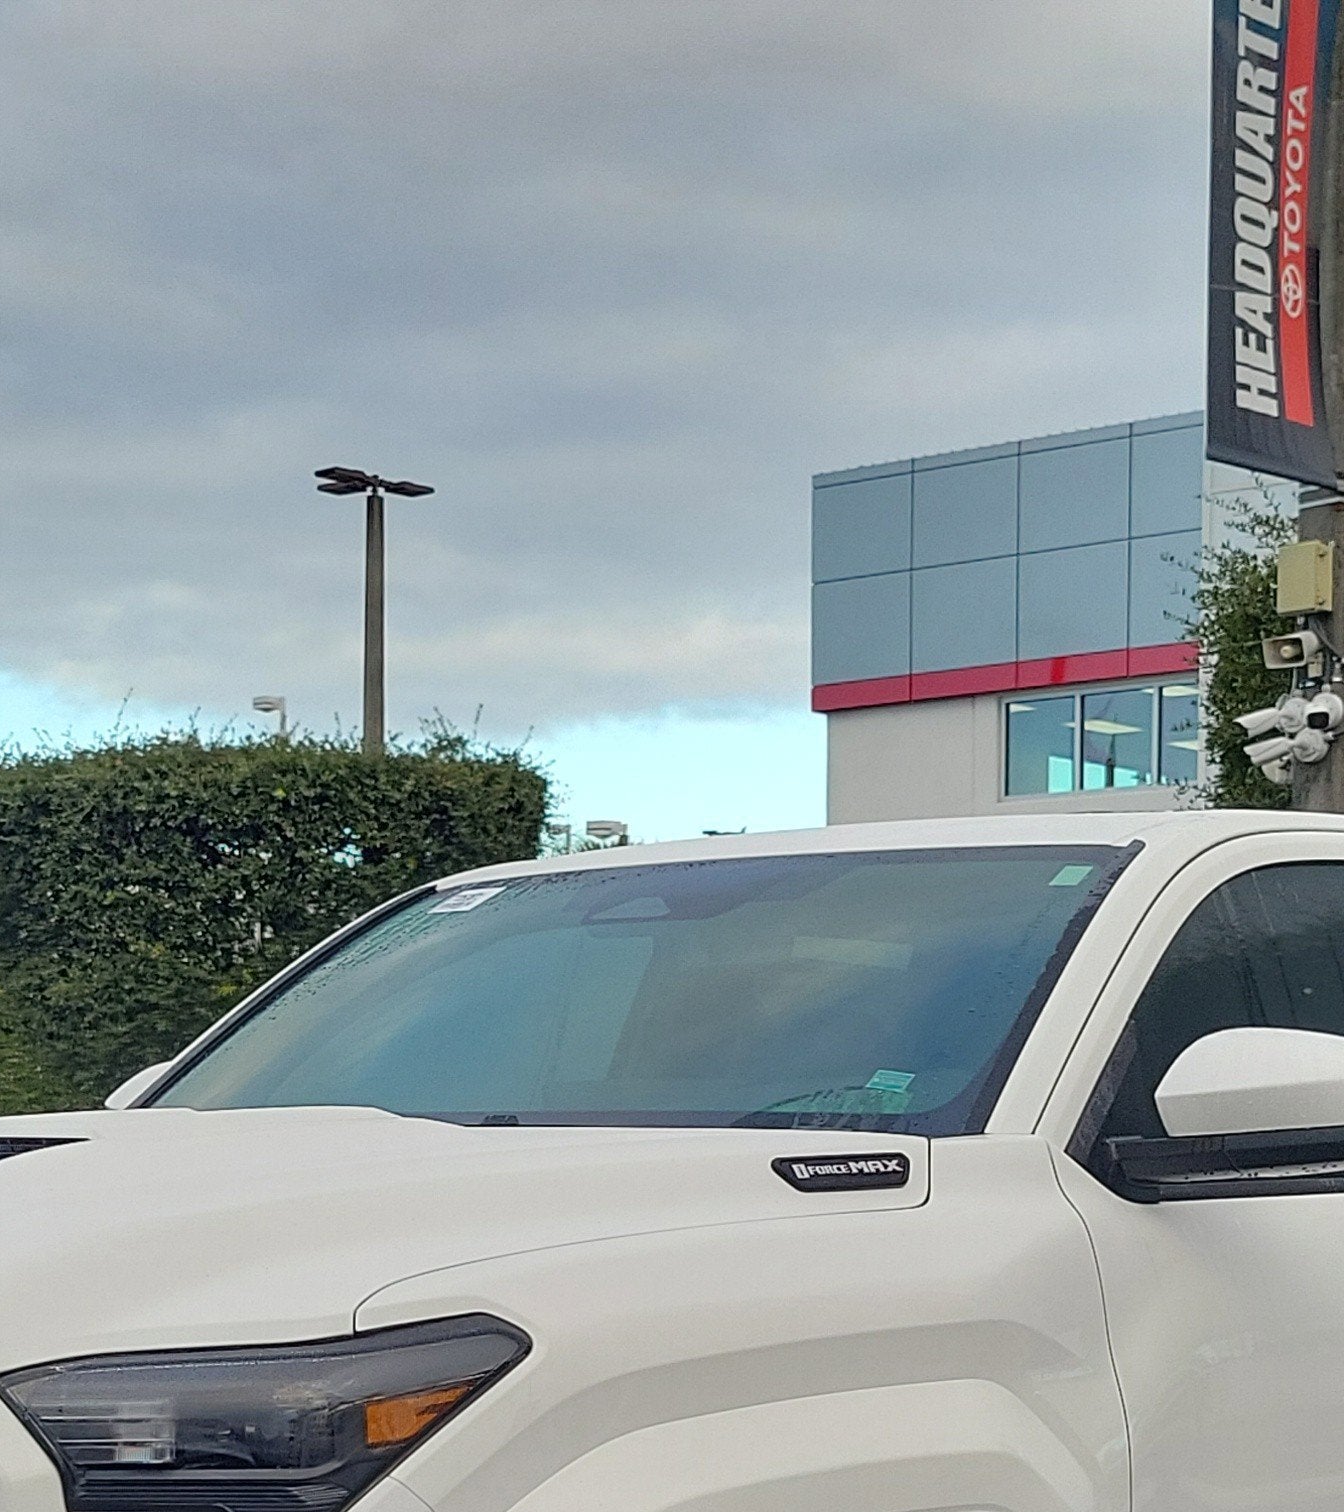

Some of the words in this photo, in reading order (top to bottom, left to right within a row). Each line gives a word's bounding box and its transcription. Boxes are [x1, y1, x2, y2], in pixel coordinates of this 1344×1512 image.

[1233, 0, 1283, 418] HEADQUARTE
[1283, 84, 1309, 258] TOYOTA
[848, 1159, 904, 1174] MAX
